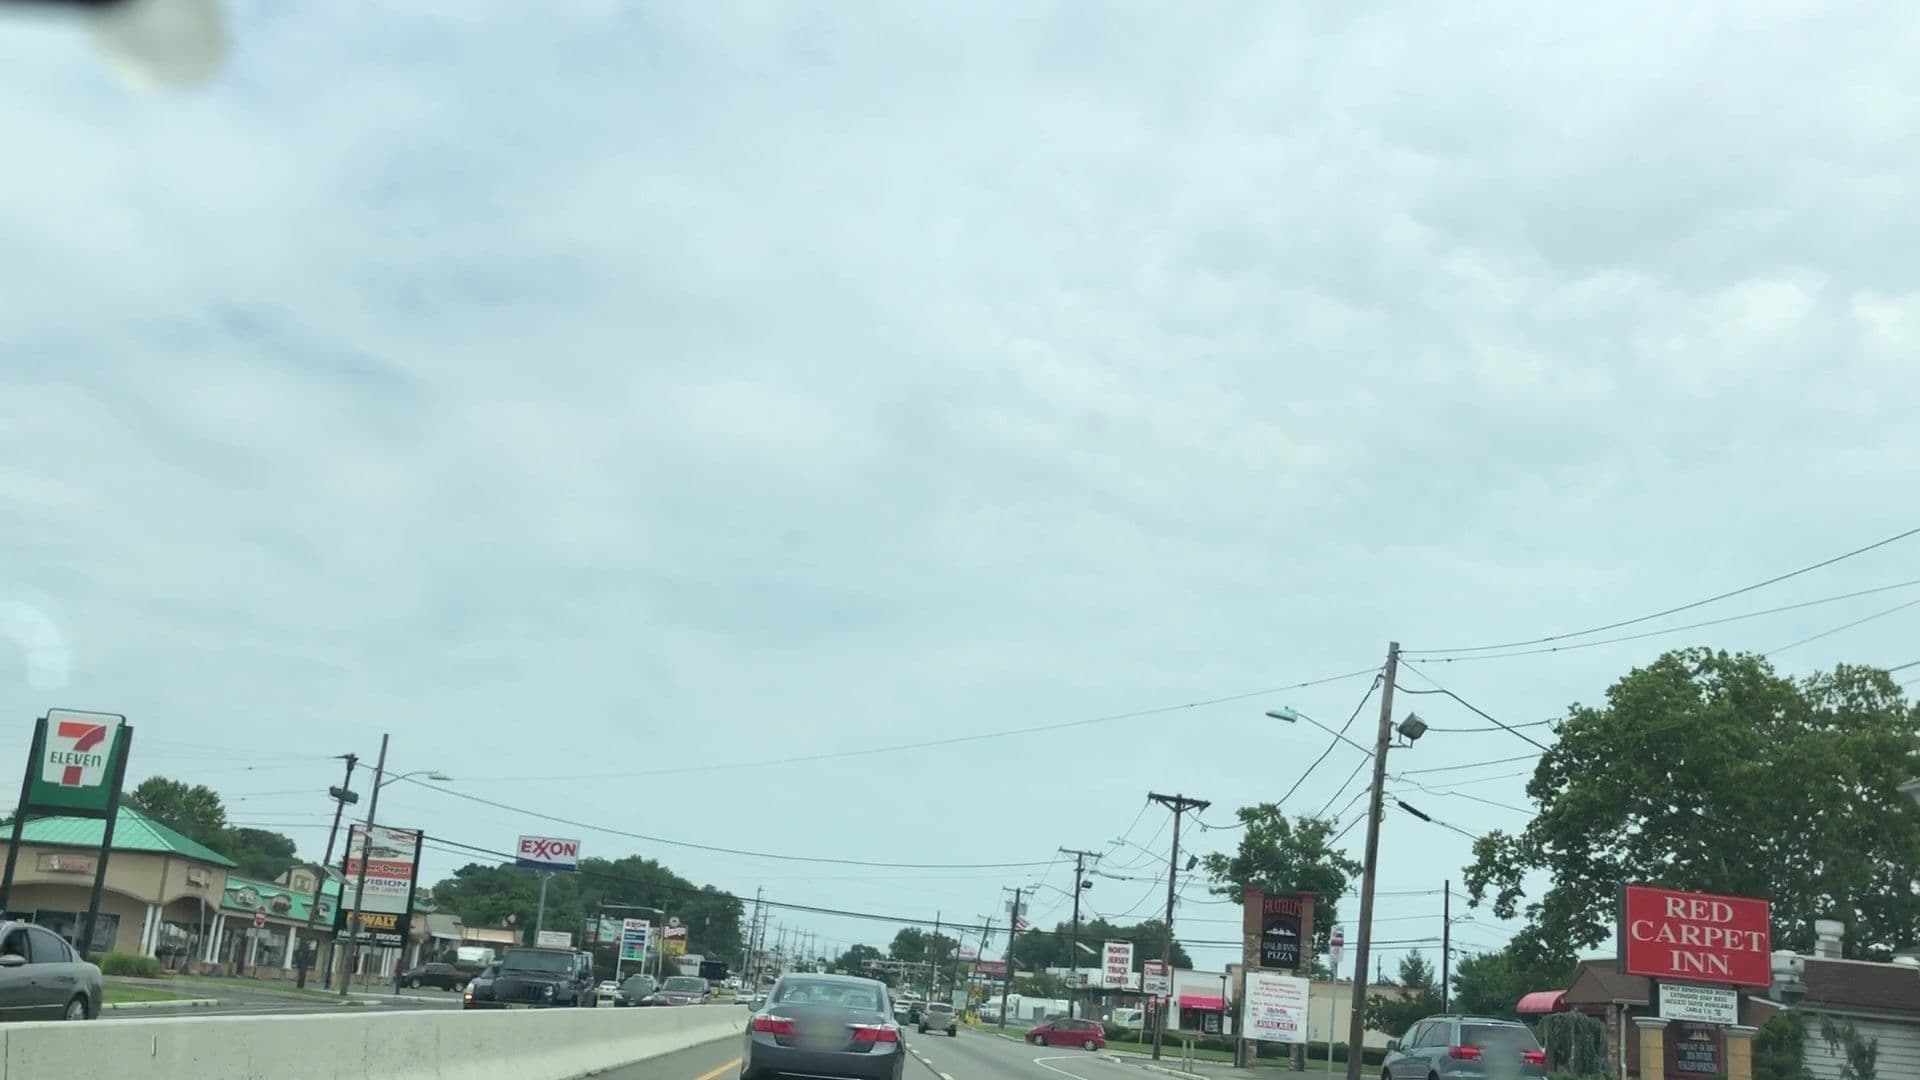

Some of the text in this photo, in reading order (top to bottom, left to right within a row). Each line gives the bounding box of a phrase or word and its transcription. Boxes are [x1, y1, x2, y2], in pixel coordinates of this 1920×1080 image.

[58, 722, 106, 786] 7
[521, 840, 577, 860] EXXON
[383, 864, 409, 873] Depot
[1664, 897, 1734, 923] RED
[1631, 919, 1766, 952] CARPET
[1108, 946, 1130, 954] NORTH
[1267, 951, 1293, 960] PIZZA
[1108, 956, 1128, 964] JERSEY
[1670, 950, 1729, 975] INN
[1108, 966, 1128, 974] TRUCK
